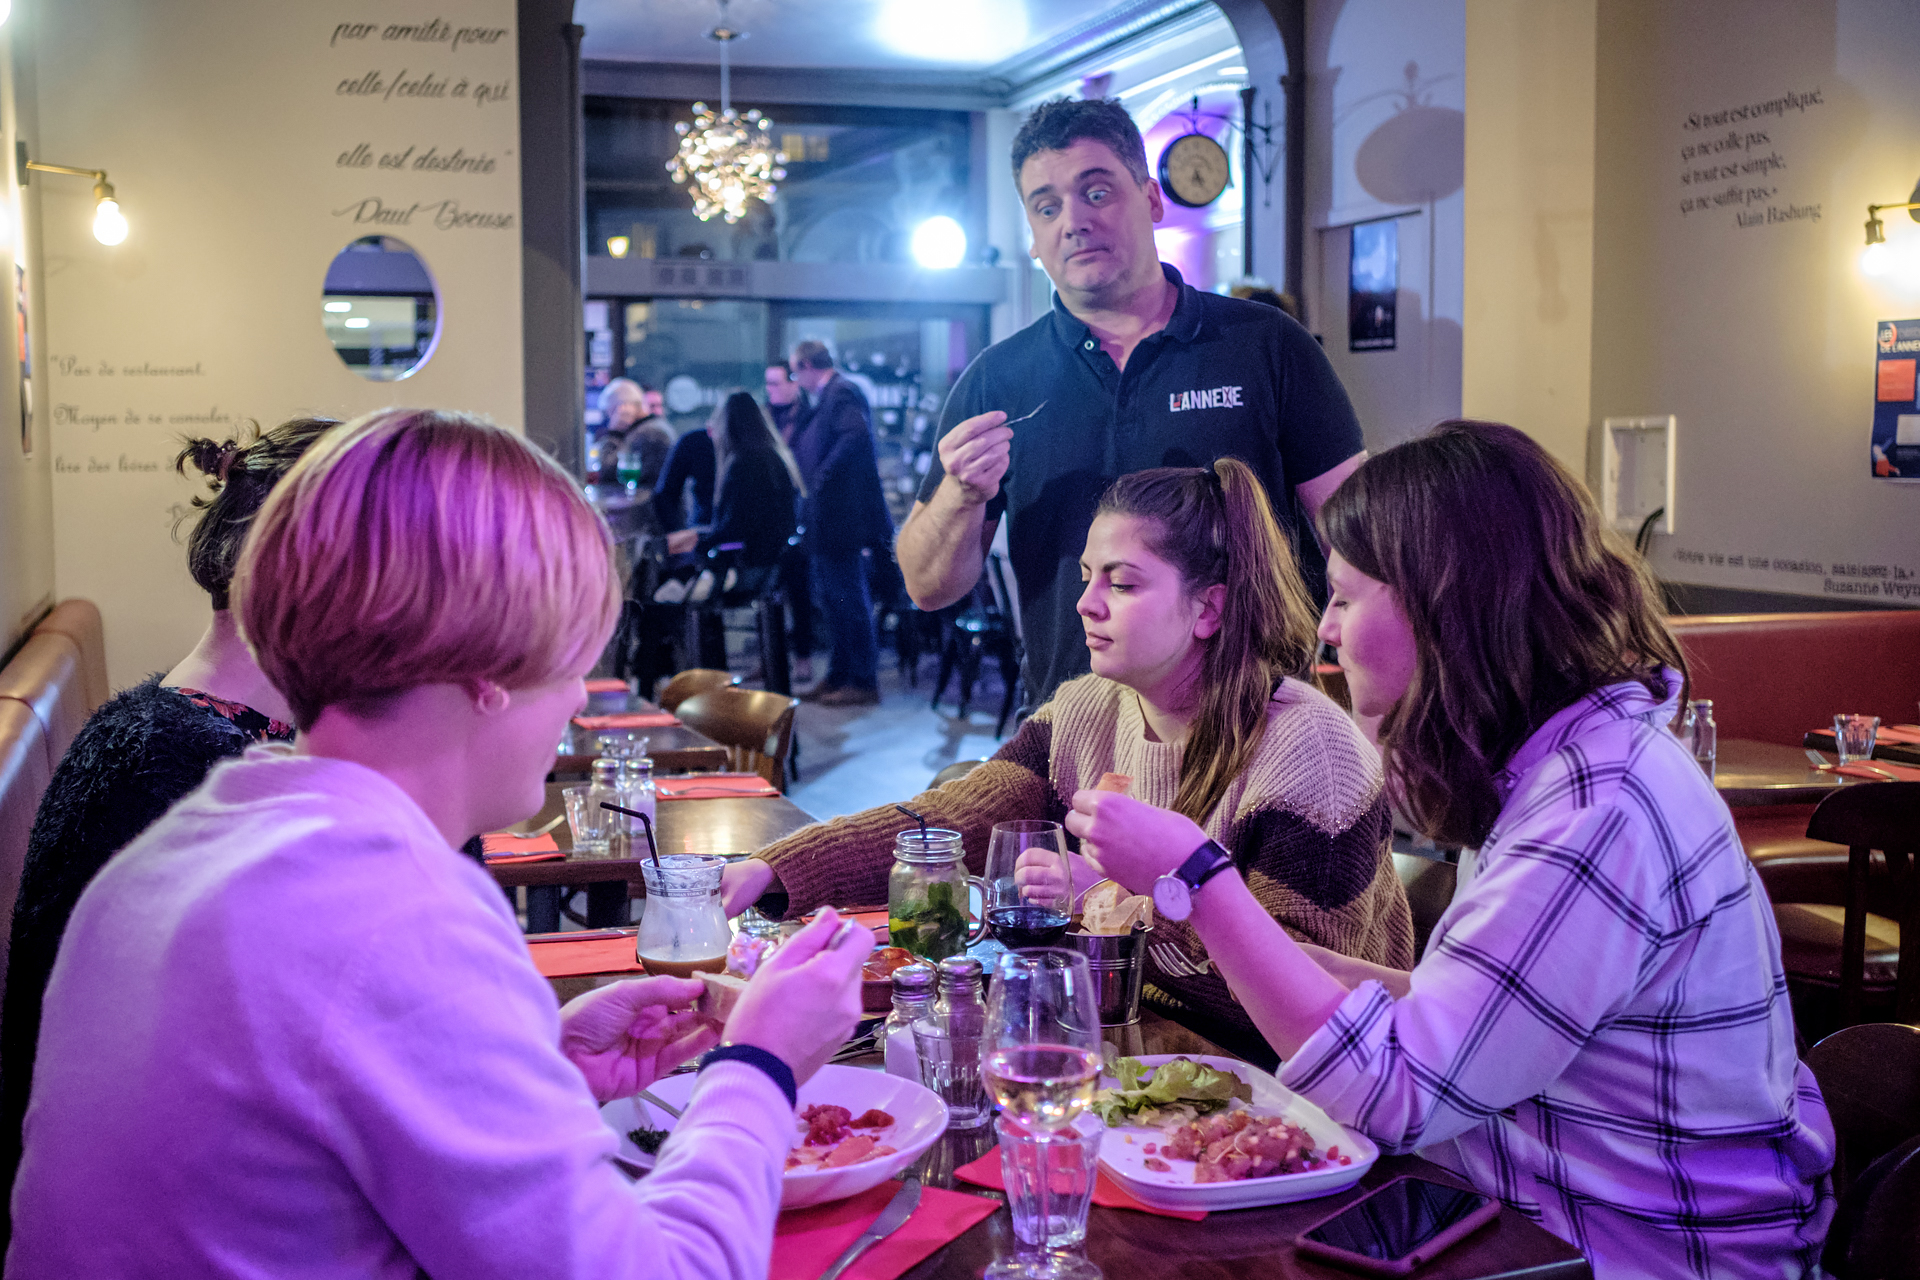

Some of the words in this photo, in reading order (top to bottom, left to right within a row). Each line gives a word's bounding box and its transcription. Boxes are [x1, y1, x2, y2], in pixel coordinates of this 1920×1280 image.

[330, 22, 378, 48] par
[450, 26, 508, 53] pour
[472, 78, 510, 108] qui
[336, 142, 373, 169] elle
[377, 144, 415, 170] est
[98, 360, 115, 377] de
[53, 402, 117, 432] Moyen
[124, 407, 141, 425] de
[1823, 577, 1879, 596] Suzanne
